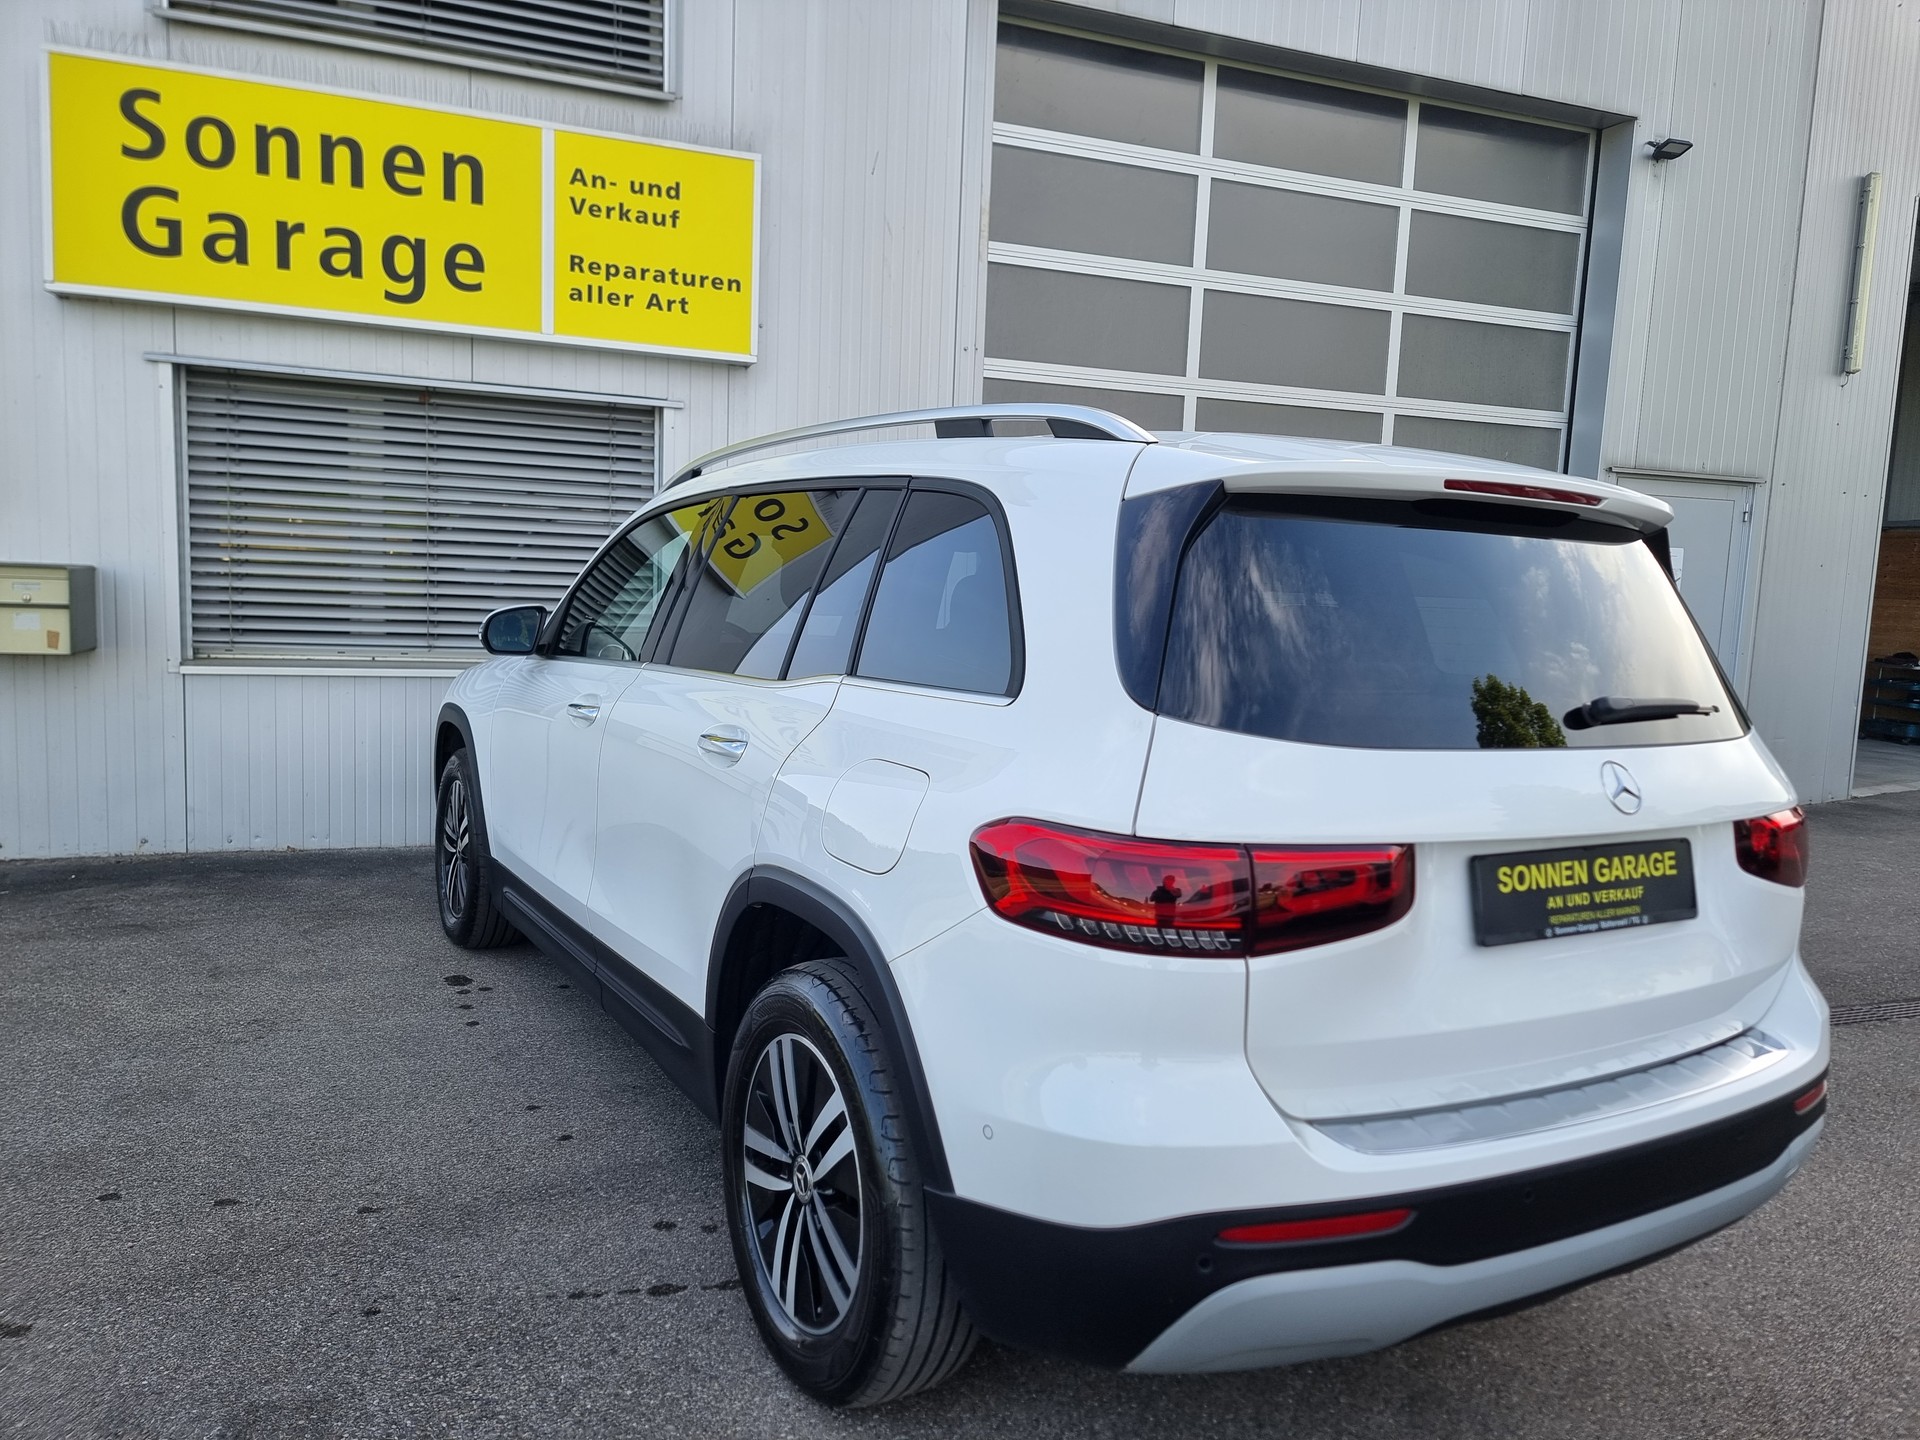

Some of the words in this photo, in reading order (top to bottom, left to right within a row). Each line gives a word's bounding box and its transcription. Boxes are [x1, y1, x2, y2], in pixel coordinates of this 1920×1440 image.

[118, 87, 485, 206] Sonnen
[569, 167, 617, 190] An-
[629, 180, 681, 201] und
[569, 196, 680, 229] Verkauf
[121, 185, 486, 305] Garage
[569, 254, 742, 293] Reparaturen
[569, 285, 635, 308] aller
[645, 293, 689, 315] Art
[1497, 860, 1588, 893] SONNEN
[1594, 851, 1677, 883] GARAGE
[1547, 896, 1564, 909] AN
[1567, 893, 1590, 907] UND
[1593, 886, 1644, 903] VERKAUF
